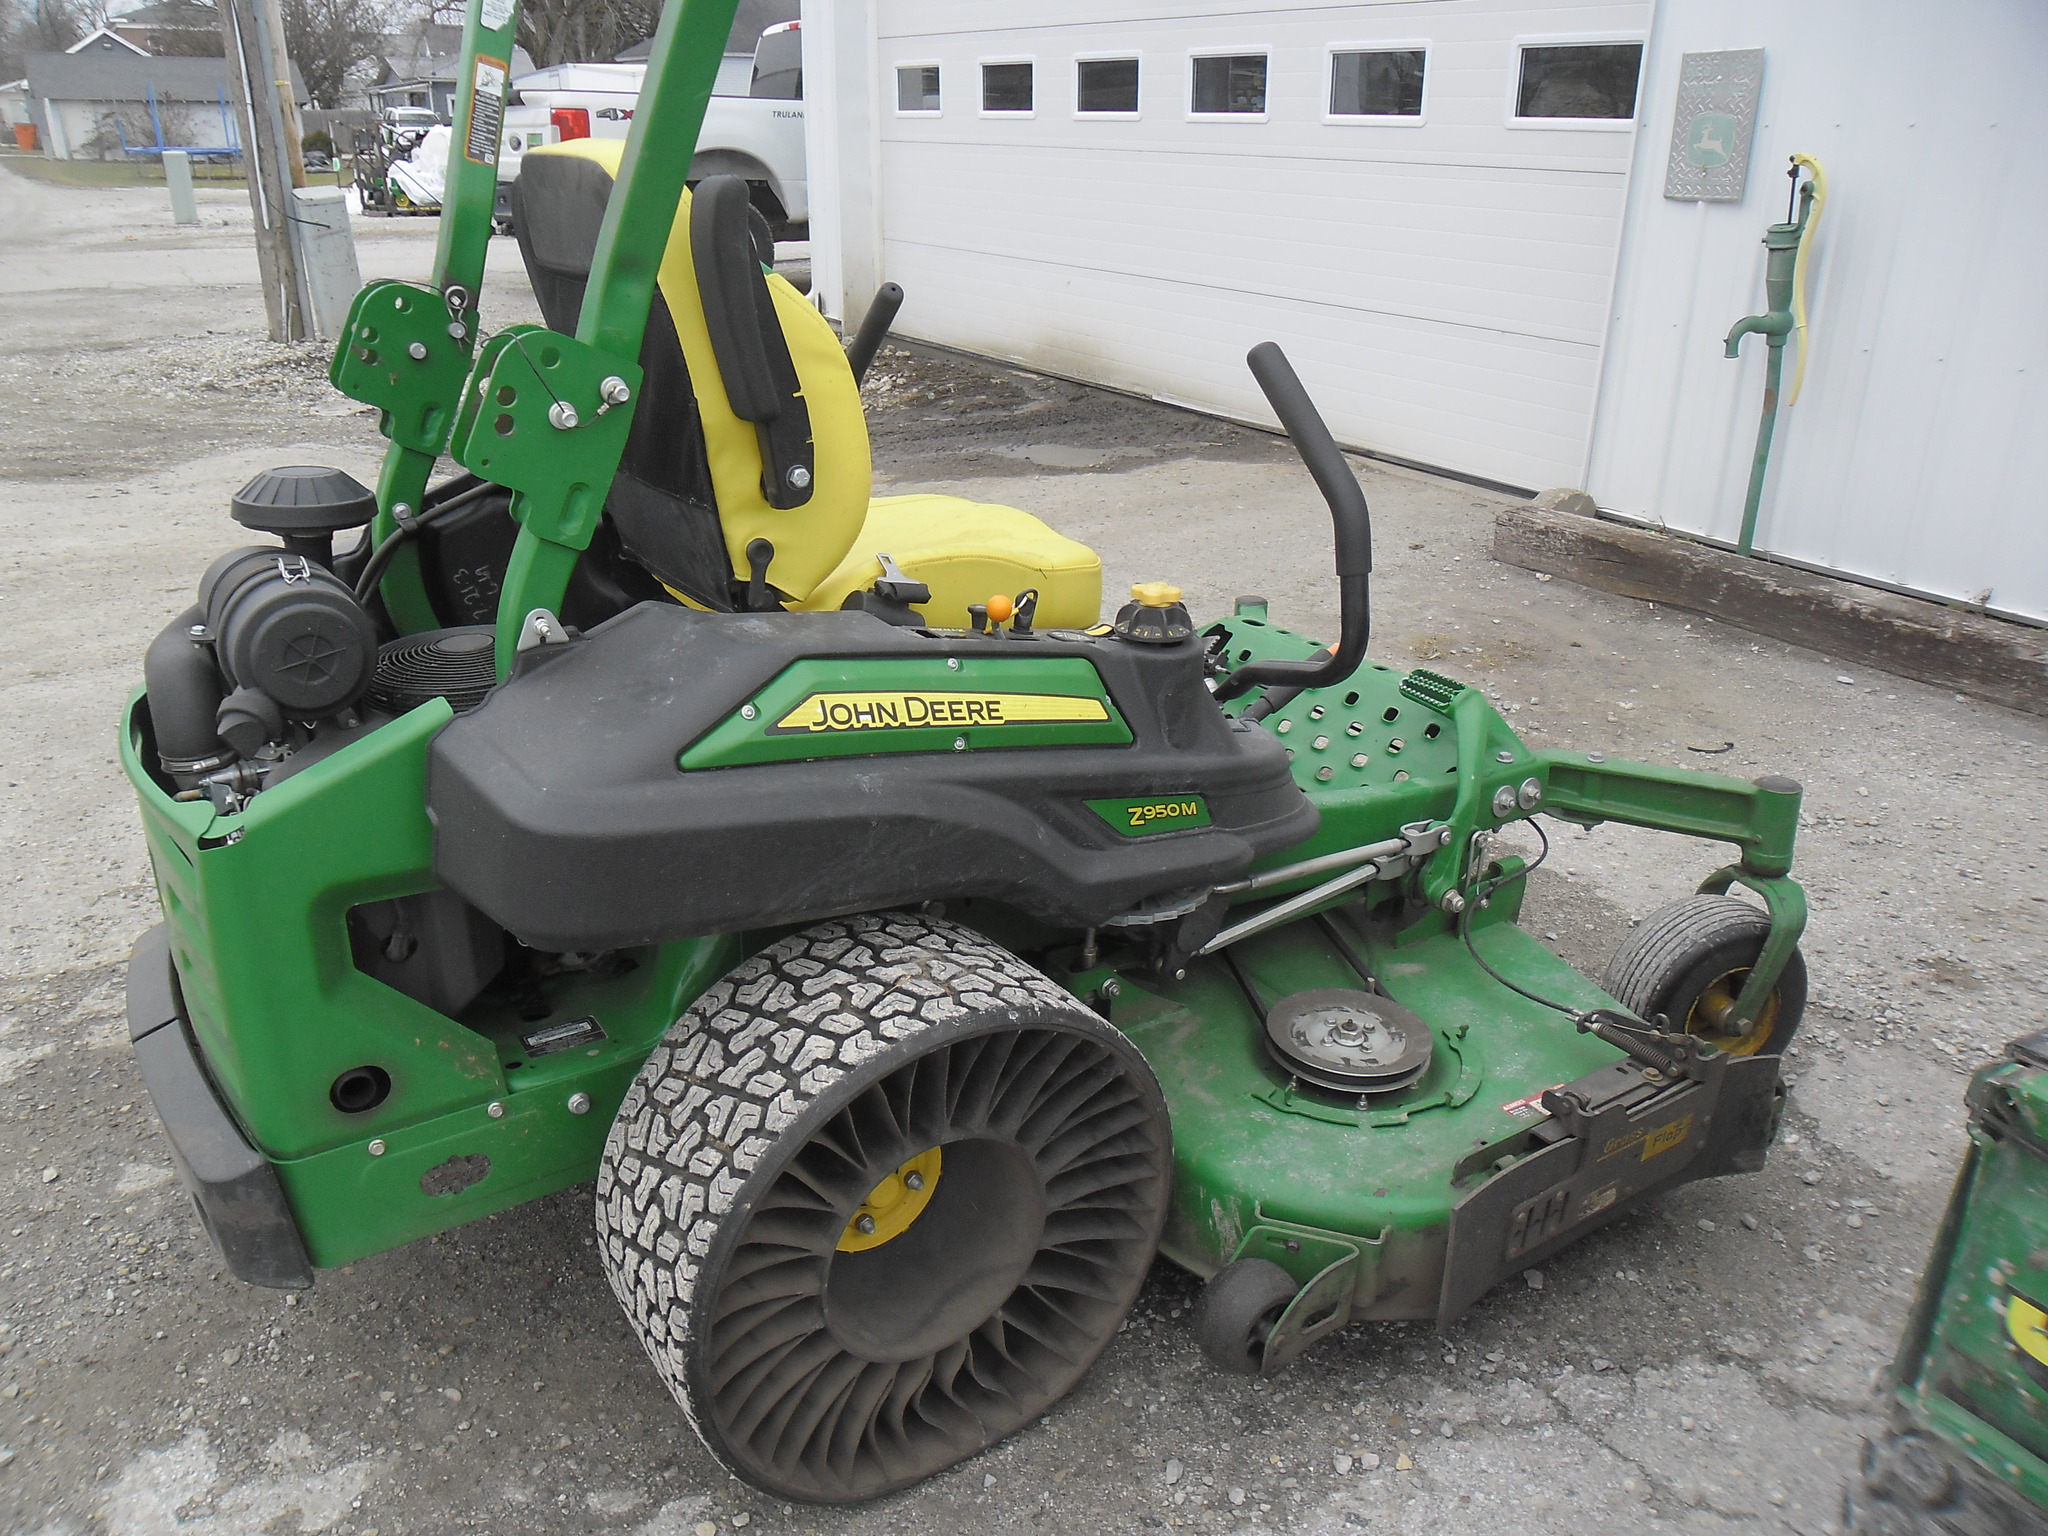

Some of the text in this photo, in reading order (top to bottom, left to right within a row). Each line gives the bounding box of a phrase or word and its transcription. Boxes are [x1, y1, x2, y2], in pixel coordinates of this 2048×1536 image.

[772, 110, 805, 120] TRULAN
[812, 696, 1004, 727] JOHN DEERE
[1127, 801, 1198, 827] Z950M
